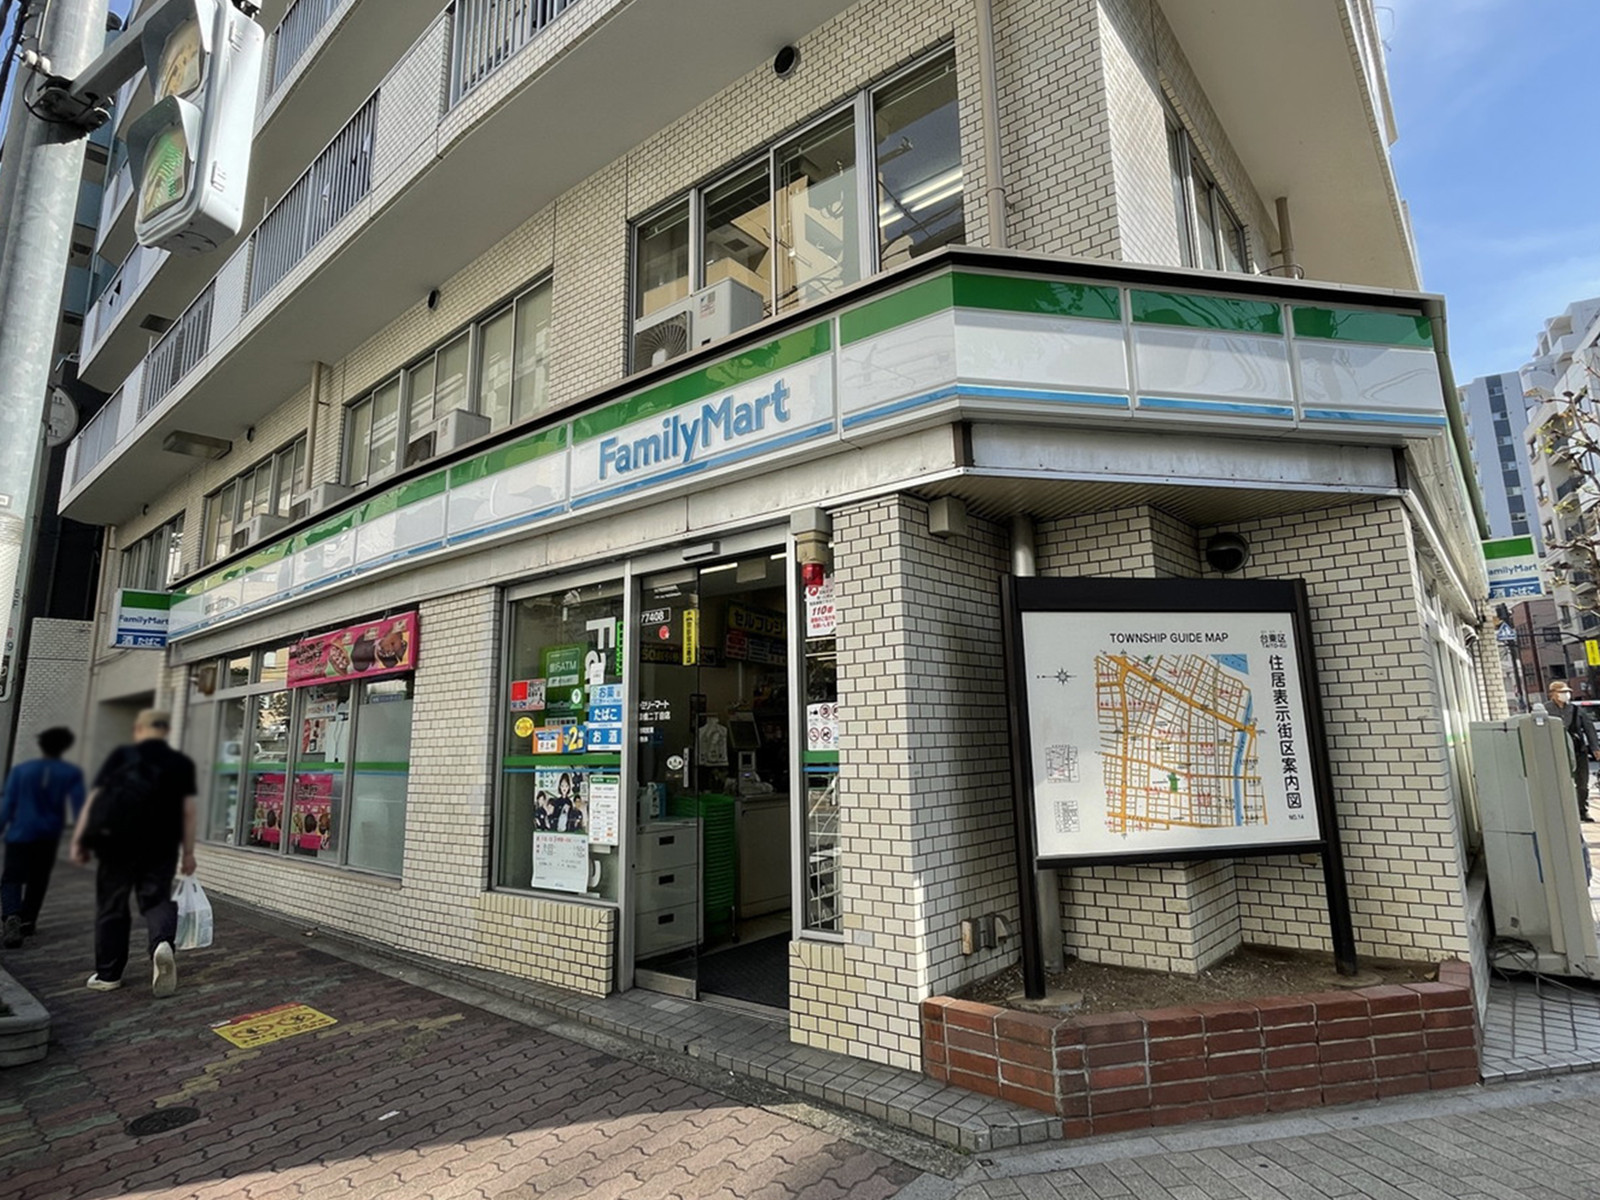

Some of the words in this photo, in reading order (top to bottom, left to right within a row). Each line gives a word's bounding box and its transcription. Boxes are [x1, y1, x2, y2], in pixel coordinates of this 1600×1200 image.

[599, 378, 791, 480] FamilyMart
[1488, 564, 1537, 575] amilyMart
[119, 614, 169, 626] FamilyMart
[1110, 632, 1167, 644] TOWNSHIP
[1170, 632, 1202, 643] GUIDE
[1205, 632, 1229, 643] MAP
[1260, 633, 1286, 643] 台東区
[594, 707, 618, 721] たばこ
[1268, 655, 1302, 809] 住居表示街区案内図
